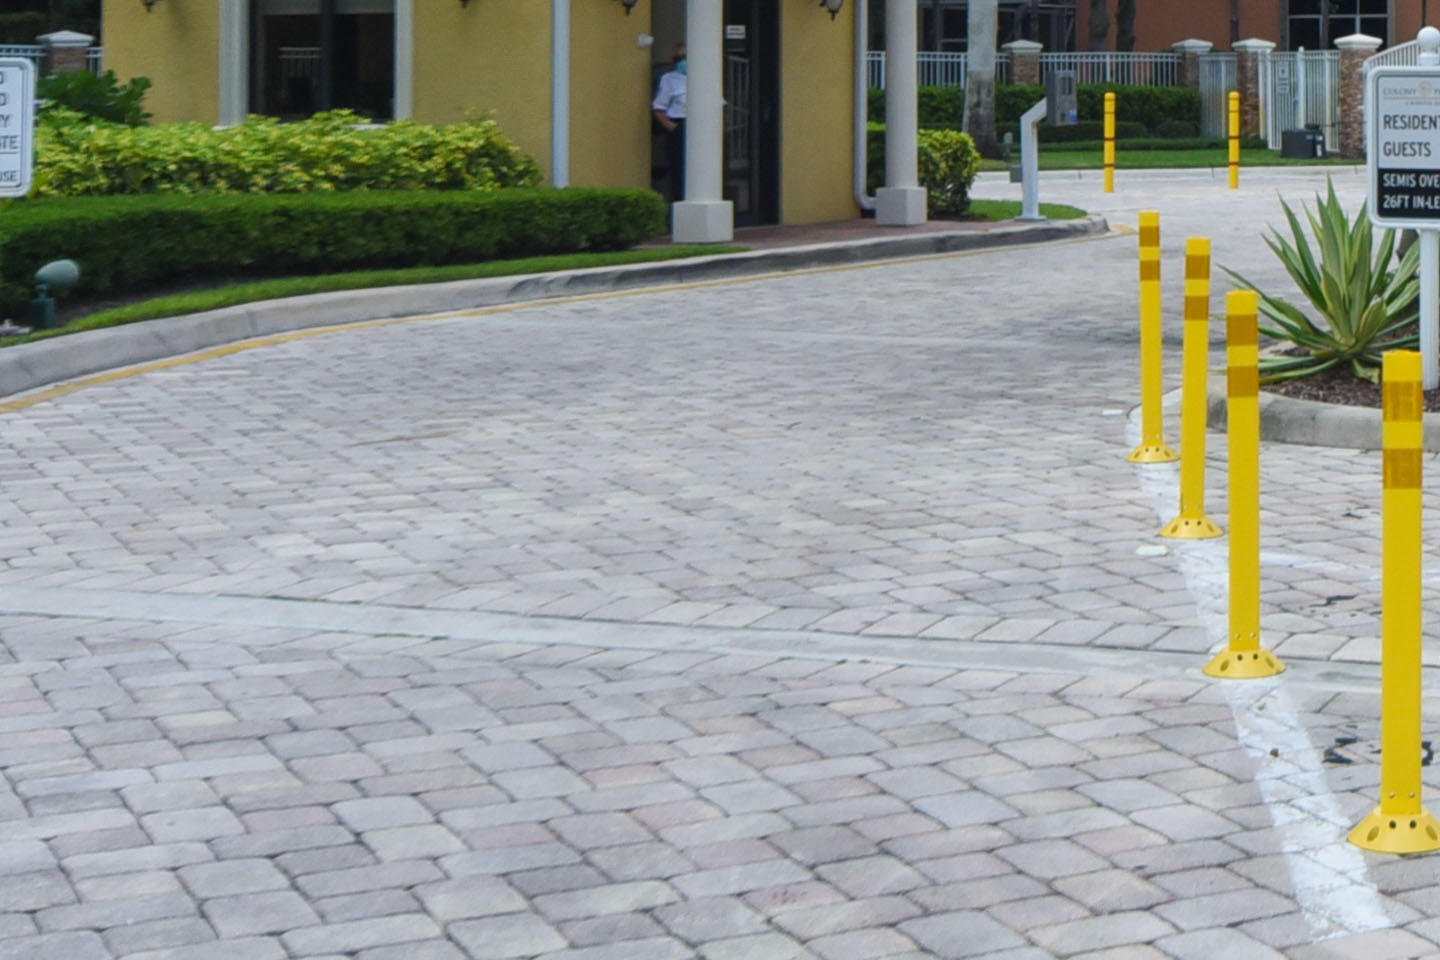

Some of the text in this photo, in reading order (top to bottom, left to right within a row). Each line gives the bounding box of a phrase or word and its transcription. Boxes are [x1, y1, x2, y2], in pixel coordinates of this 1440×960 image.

[1383, 141, 1431, 157] GUESTS
[1383, 173, 1416, 188] SEMIS
[1383, 194, 1409, 209] 26FT
